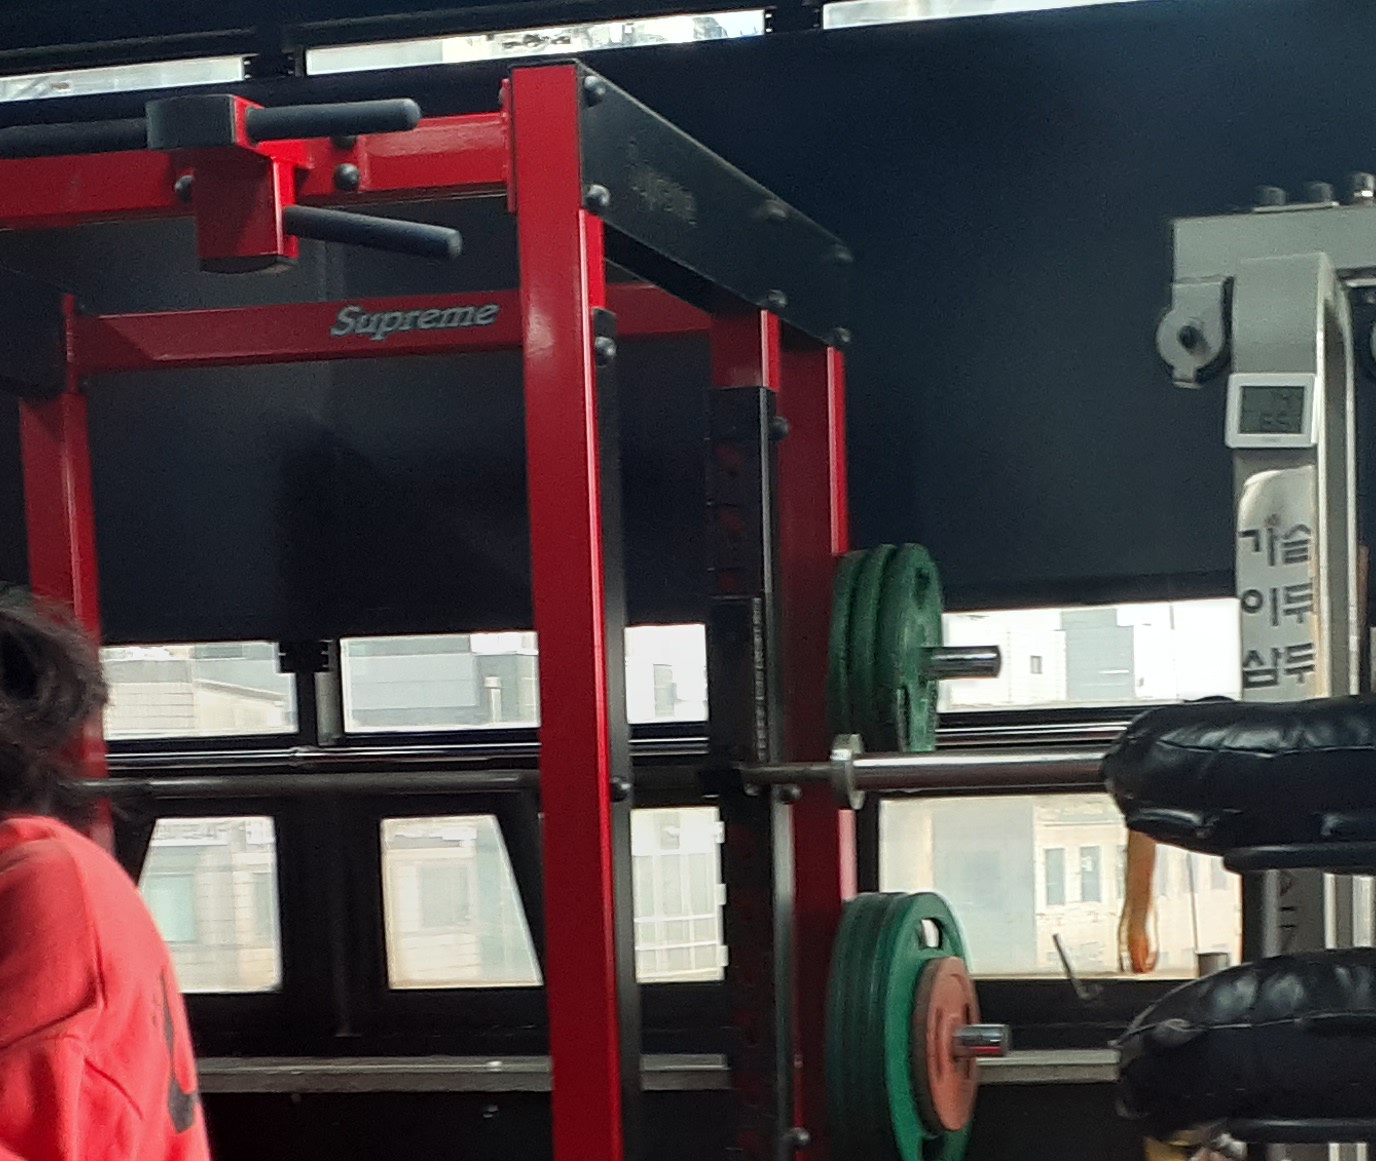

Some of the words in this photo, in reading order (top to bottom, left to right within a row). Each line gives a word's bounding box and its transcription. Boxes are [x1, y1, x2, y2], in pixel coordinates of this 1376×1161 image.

[330, 304, 500, 340] Supreme
[1240, 582, 1314, 626] 이두
[1242, 642, 1315, 688] 삼두
